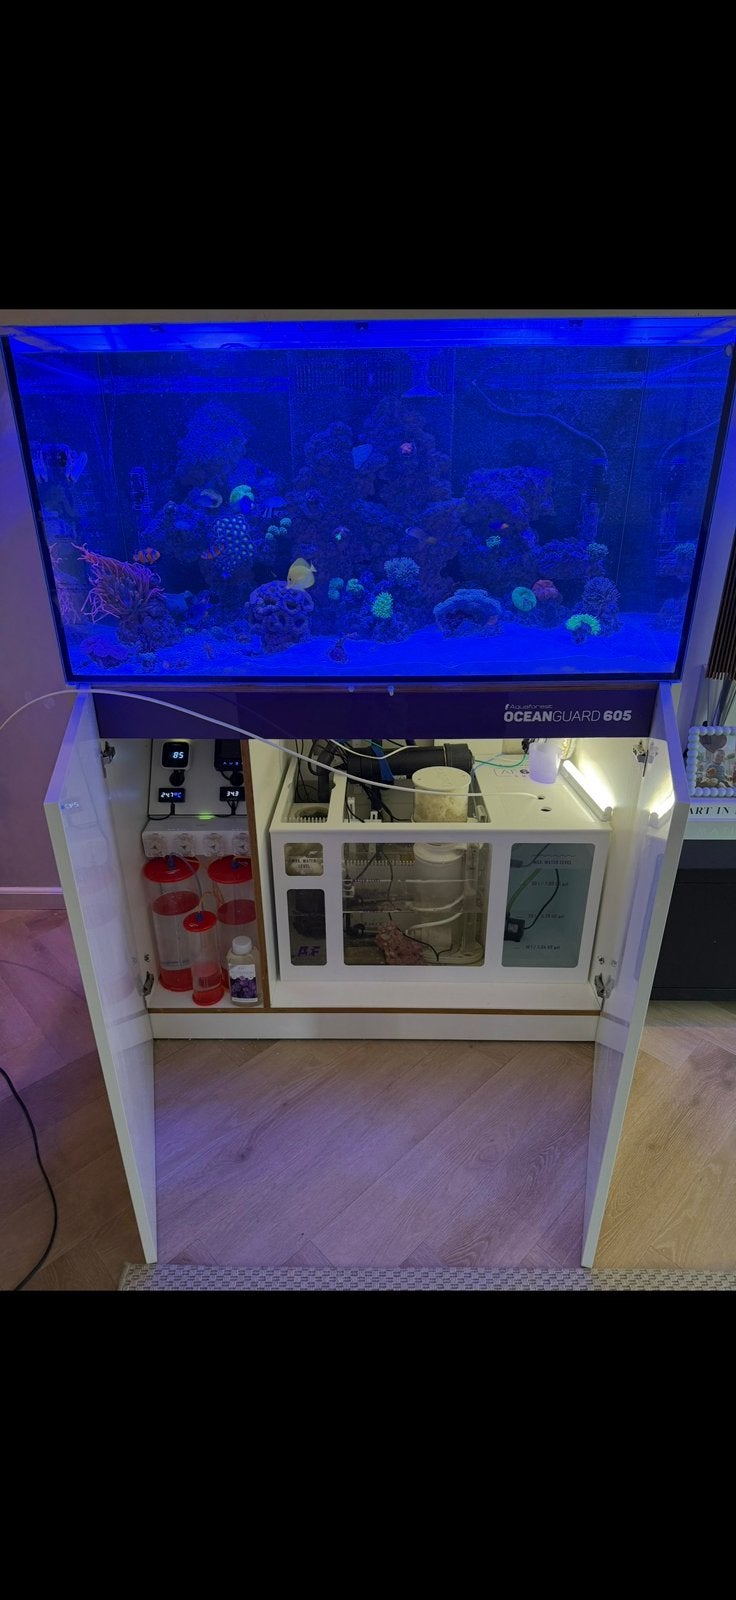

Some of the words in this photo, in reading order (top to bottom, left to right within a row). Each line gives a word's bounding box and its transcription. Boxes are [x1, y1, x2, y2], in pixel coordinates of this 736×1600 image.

[504, 710, 601, 723] OCEANGUARD
[603, 710, 632, 721] 605
[172, 751, 184, 759] 85
